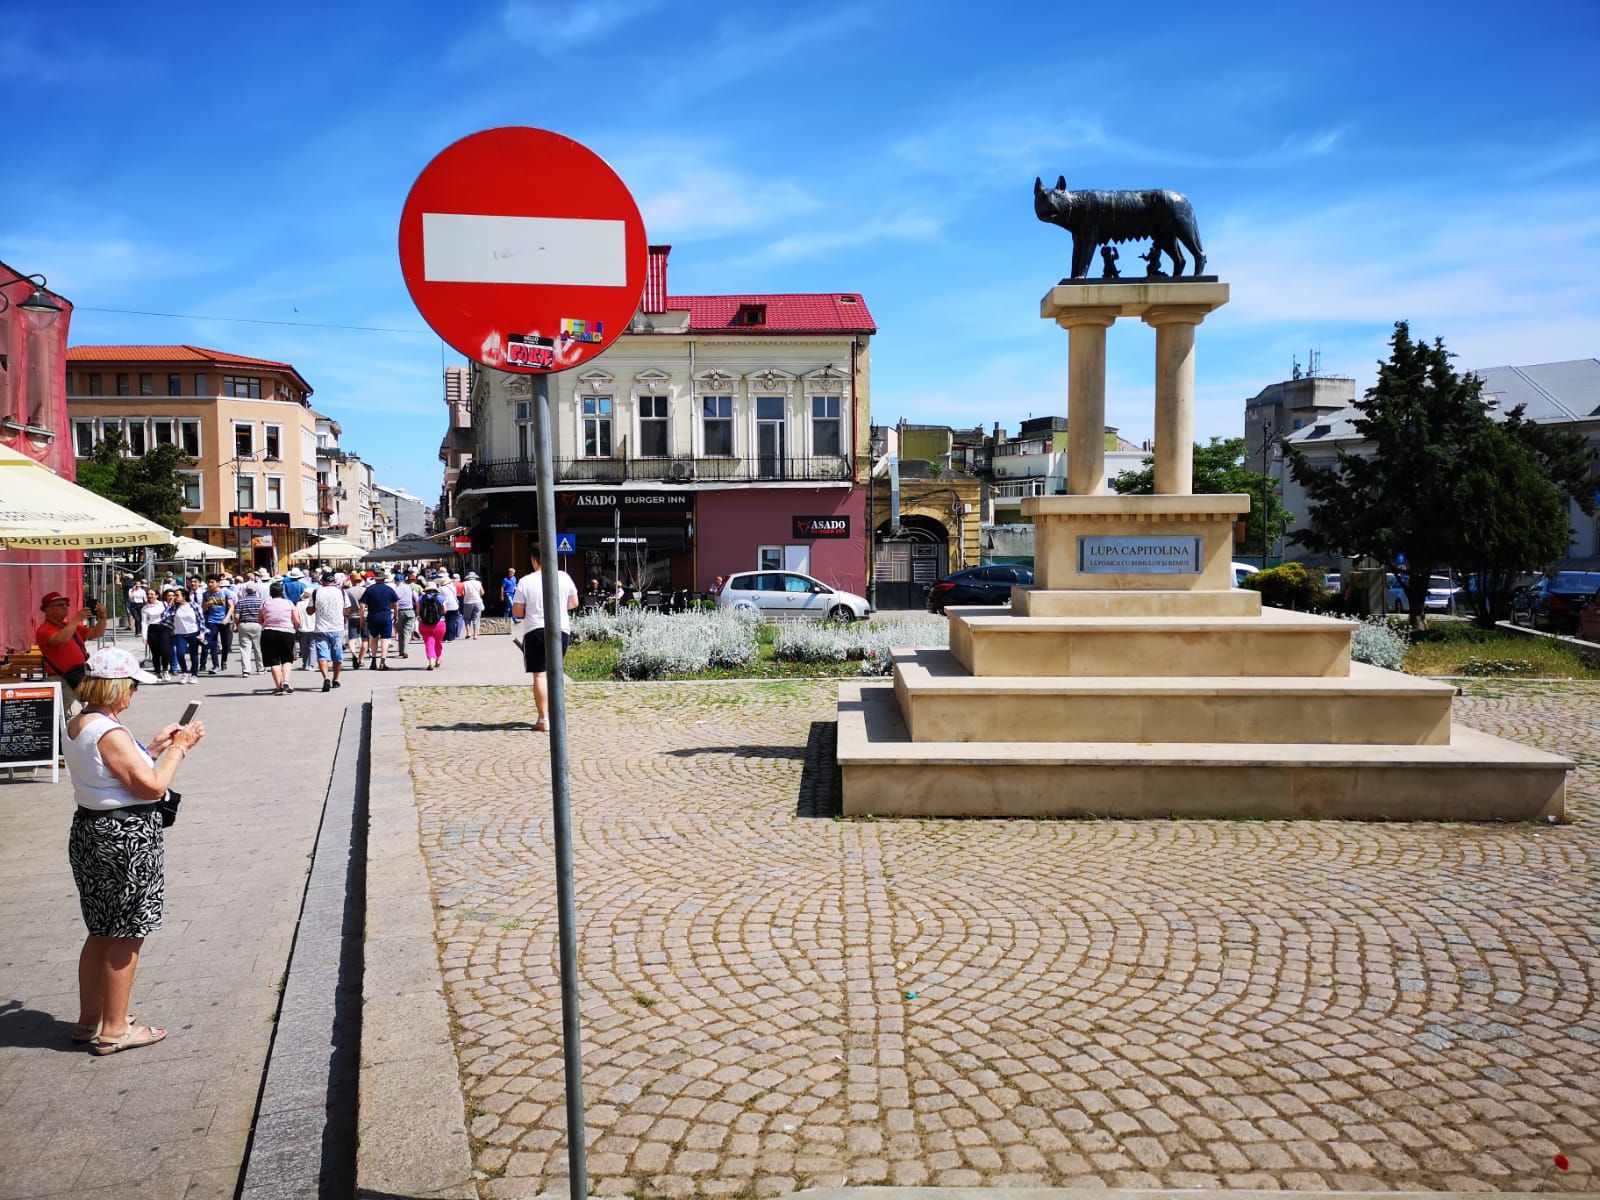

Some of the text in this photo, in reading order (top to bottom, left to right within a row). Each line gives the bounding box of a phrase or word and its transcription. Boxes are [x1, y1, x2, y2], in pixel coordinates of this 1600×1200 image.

[577, 495, 686, 506] ASADO BURGER INN
[811, 520, 846, 529] ASADO
[1090, 546, 1189, 556] LUPA CAPITOLINA
